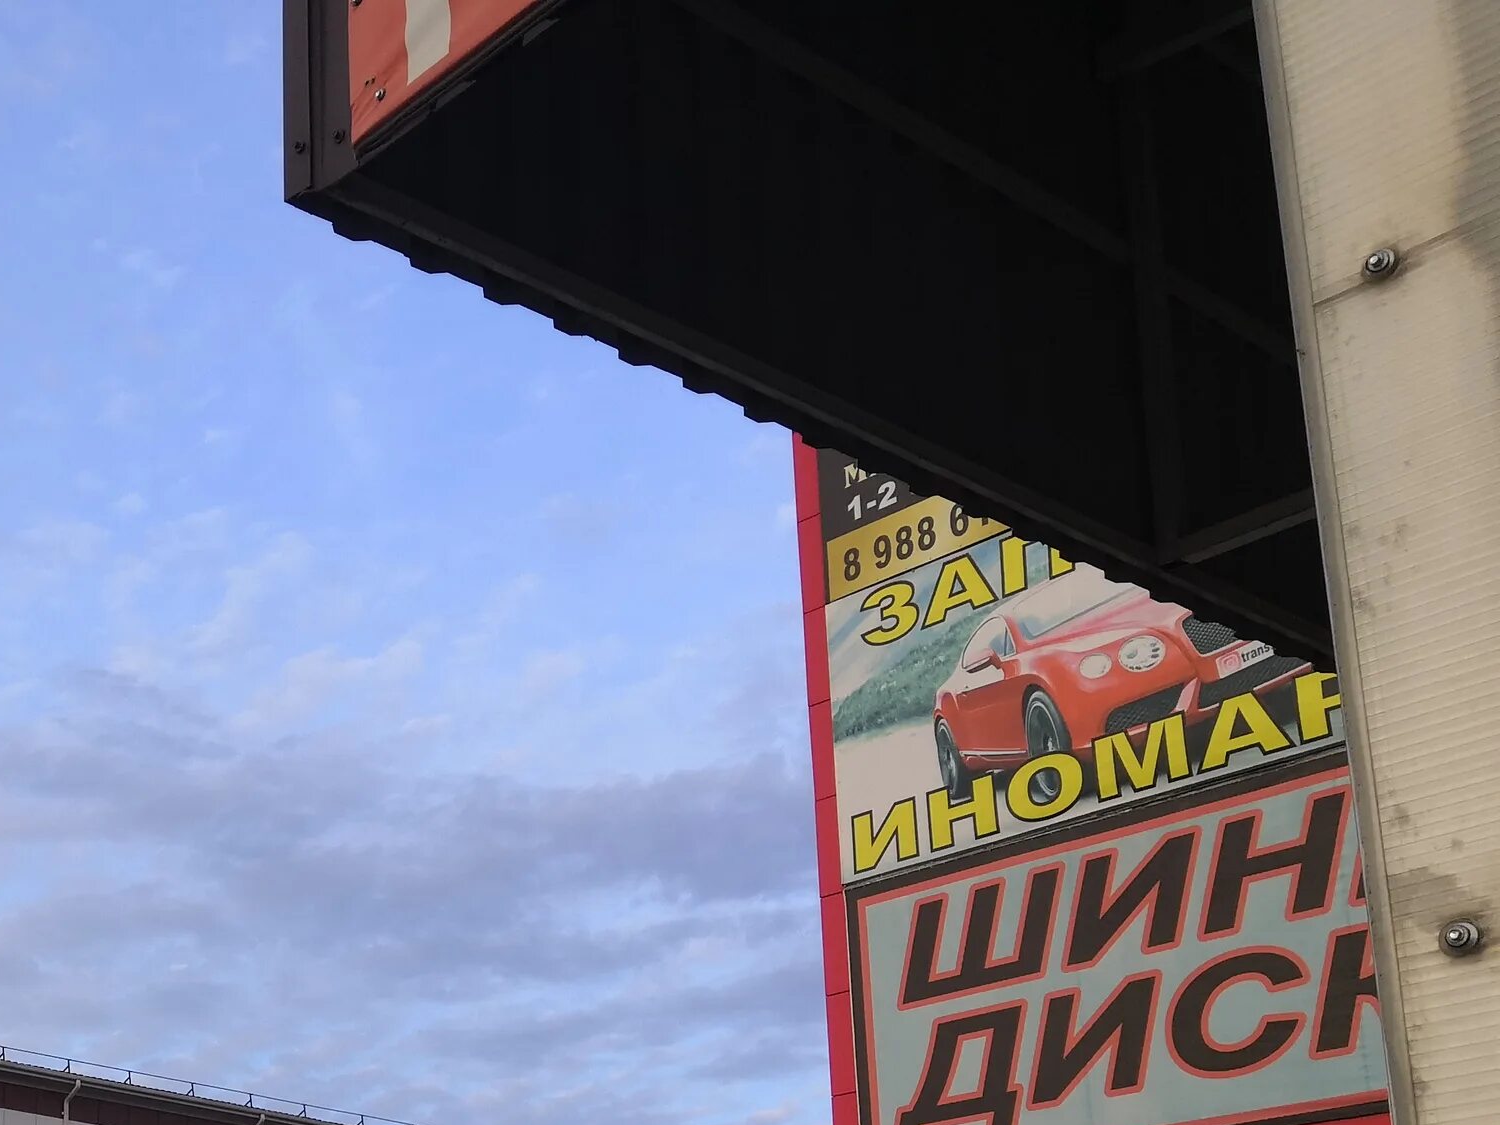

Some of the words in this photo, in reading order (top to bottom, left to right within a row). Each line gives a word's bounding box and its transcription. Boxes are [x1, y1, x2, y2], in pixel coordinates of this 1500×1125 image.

[848, 481, 897, 520] 1-2
[844, 548, 861, 581] 8
[874, 516, 936, 569] 988
[898, 784, 1367, 1011] ШИН
